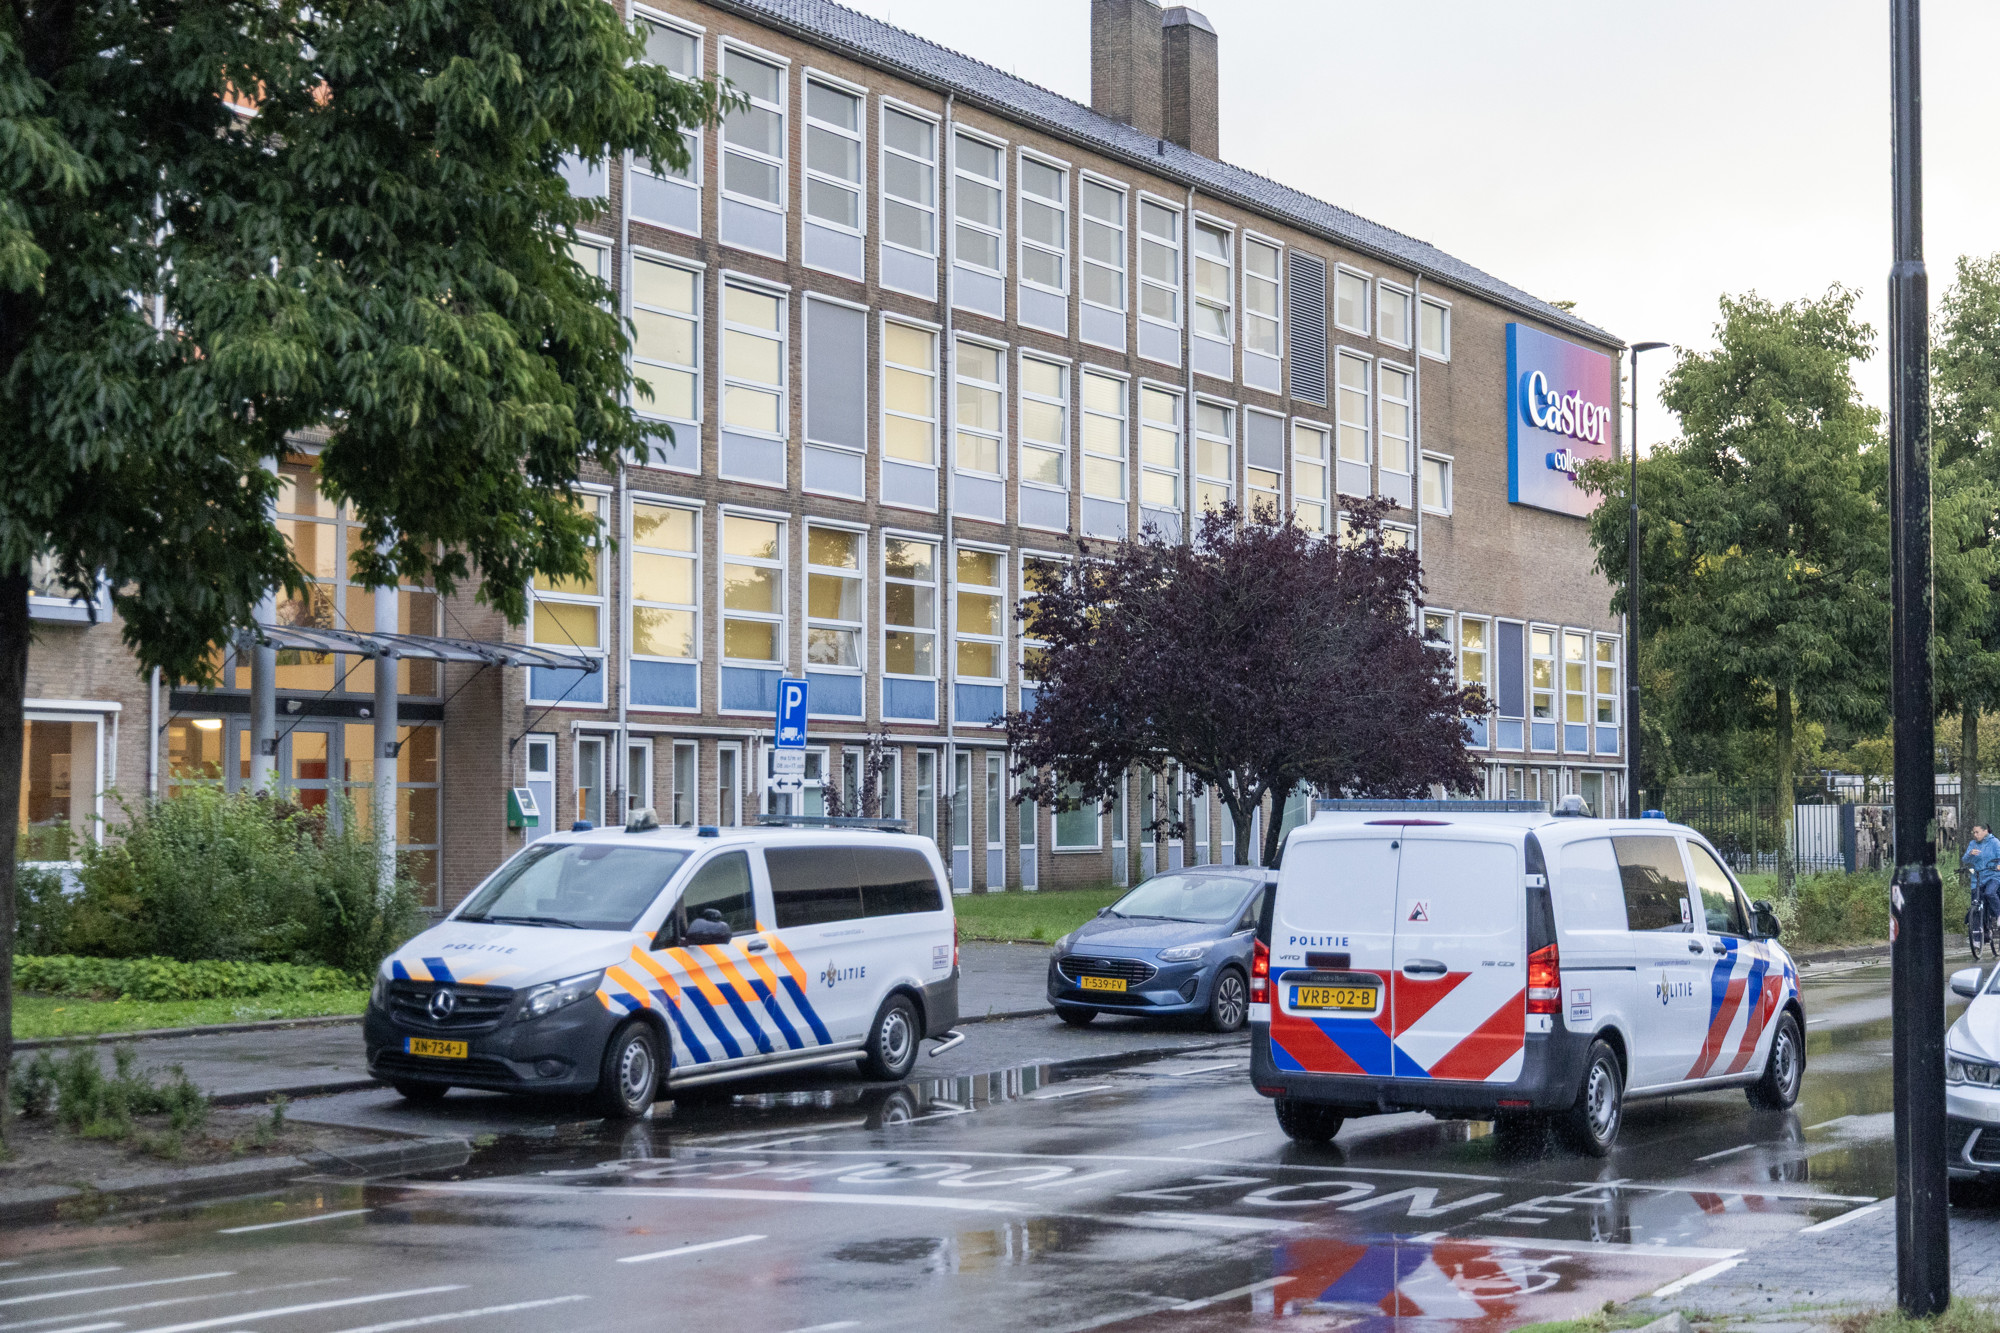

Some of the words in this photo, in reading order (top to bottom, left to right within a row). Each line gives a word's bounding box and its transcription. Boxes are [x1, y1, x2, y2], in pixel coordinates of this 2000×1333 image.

[1528, 370, 1611, 445] Caster
[1554, 447, 1585, 481] colle
[785, 685, 803, 720] P
[440, 943, 518, 954] POLITIE
[1289, 935, 1350, 947] POLITIE
[1084, 977, 1123, 990] T-539-FV
[1302, 988, 1371, 1006] VRB-02-B
[414, 1039, 463, 1056] XN-734-J
[540, 1156, 1131, 1192] SCHOOL
[1116, 1174, 1633, 1225] ZONE
